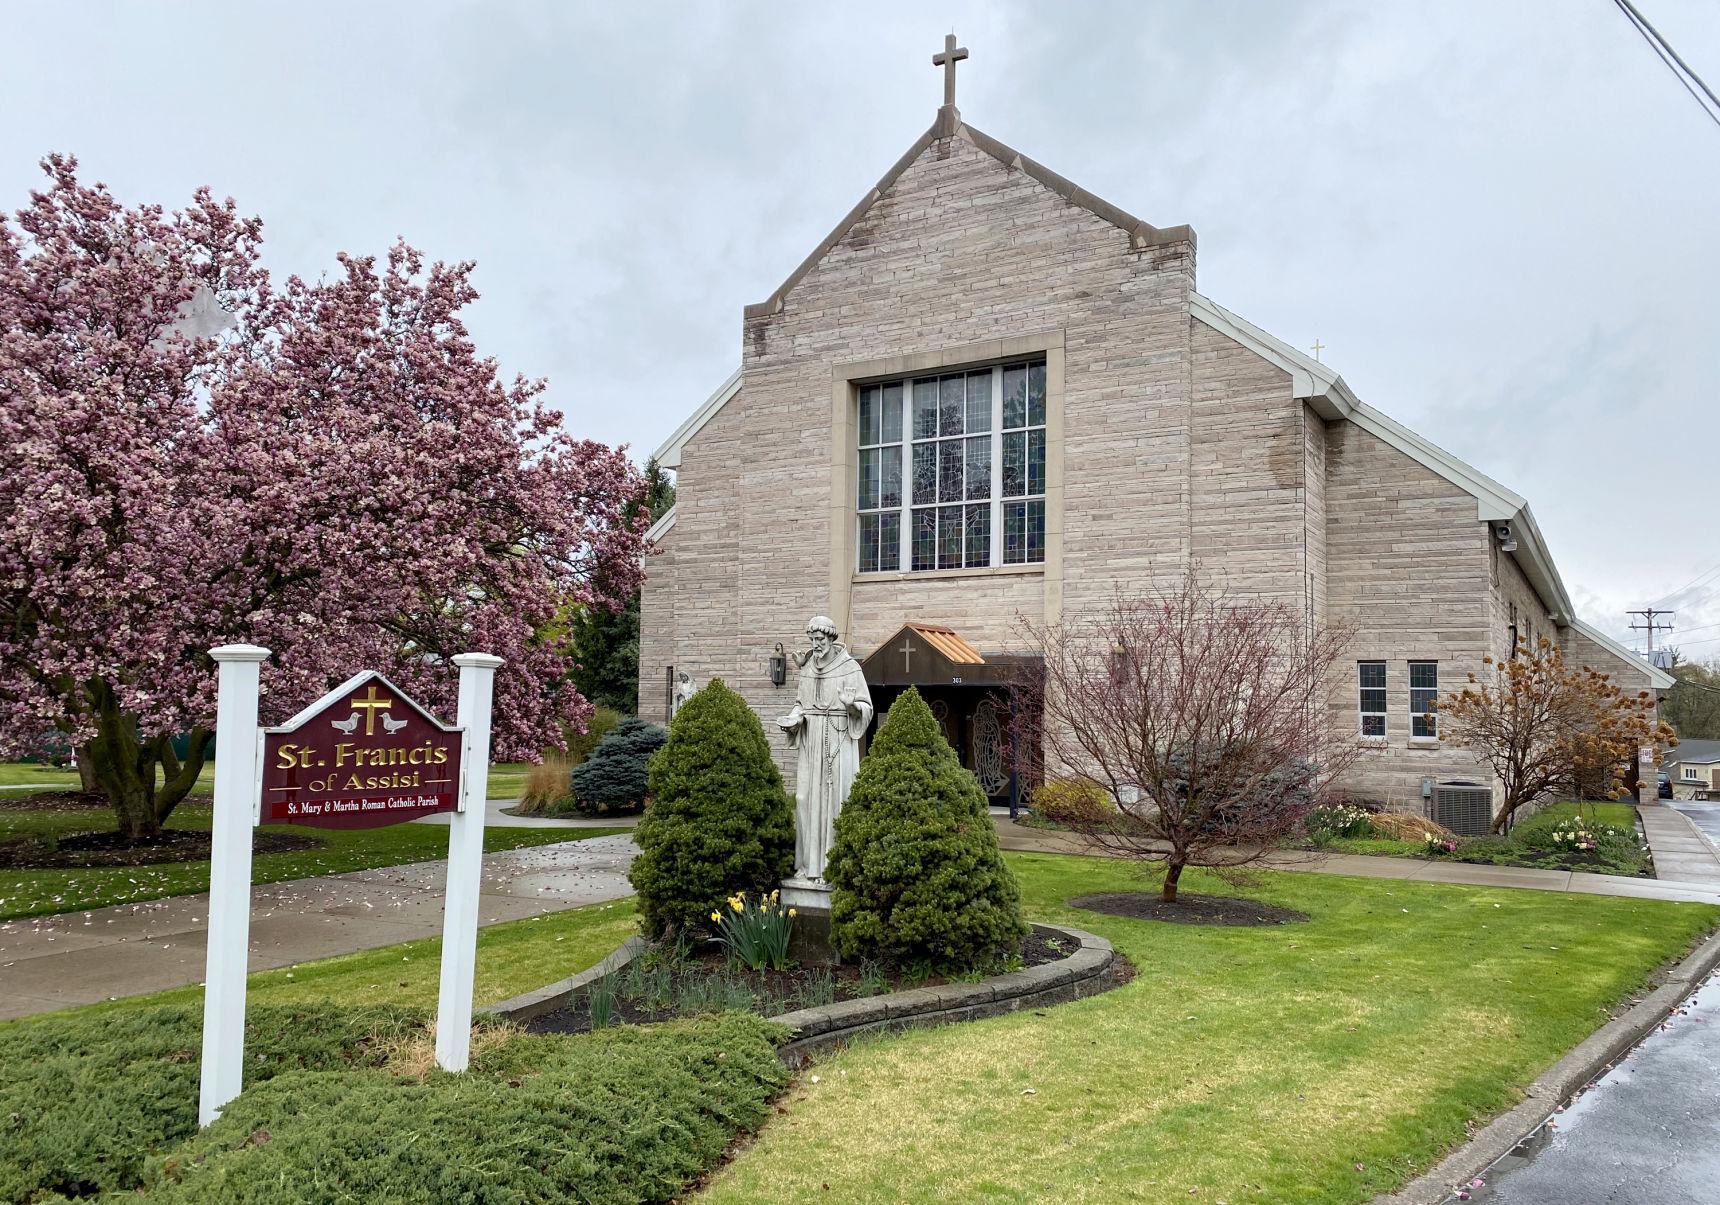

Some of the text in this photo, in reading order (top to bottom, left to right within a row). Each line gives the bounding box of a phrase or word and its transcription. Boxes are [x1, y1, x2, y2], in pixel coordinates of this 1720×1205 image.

[277, 740, 448, 769] St. Francis
[309, 771, 420, 792] of Assisi
[288, 795, 439, 815] St. Mary & Martha Roman Catholic Parish
